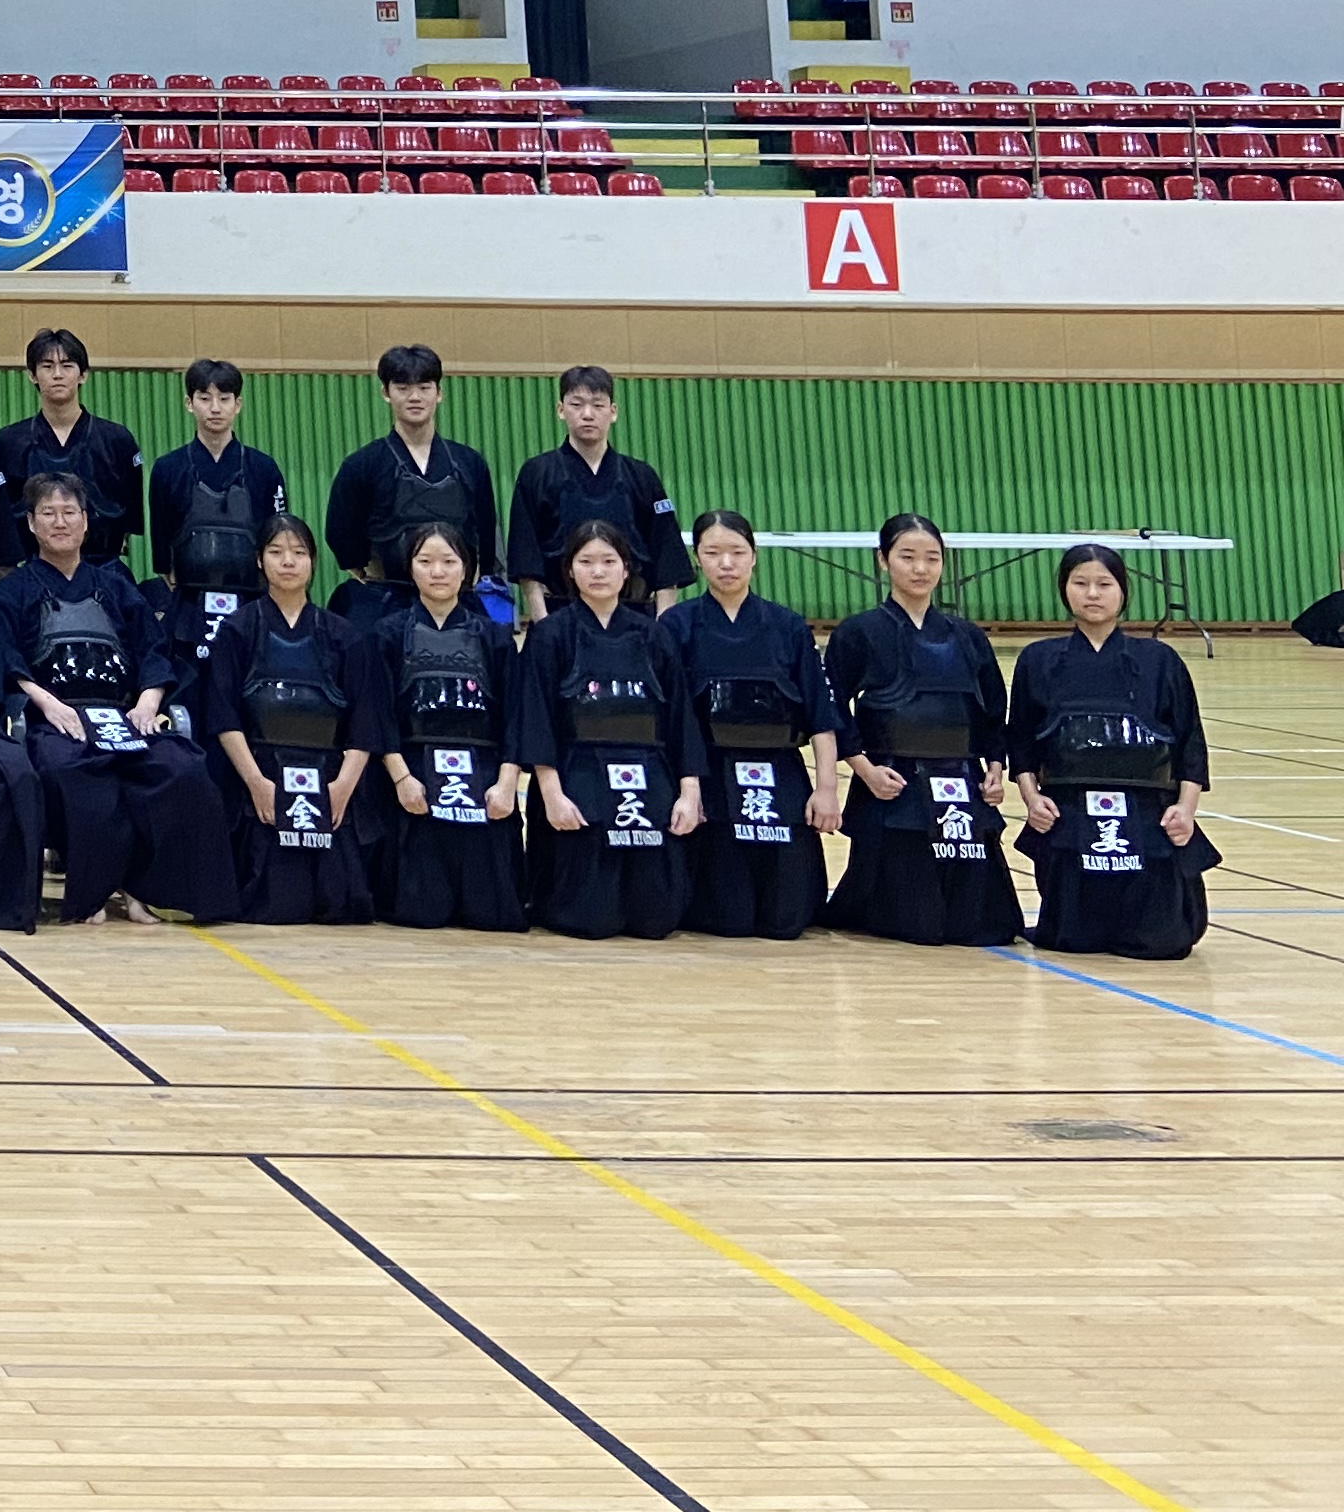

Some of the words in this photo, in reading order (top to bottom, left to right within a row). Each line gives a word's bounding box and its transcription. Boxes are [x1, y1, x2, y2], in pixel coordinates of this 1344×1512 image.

[822, 209, 888, 284] A
[439, 776, 475, 806] 文
[615, 792, 652, 828] 文
[279, 831, 300, 846] KIM
[932, 843, 956, 858] YOO
